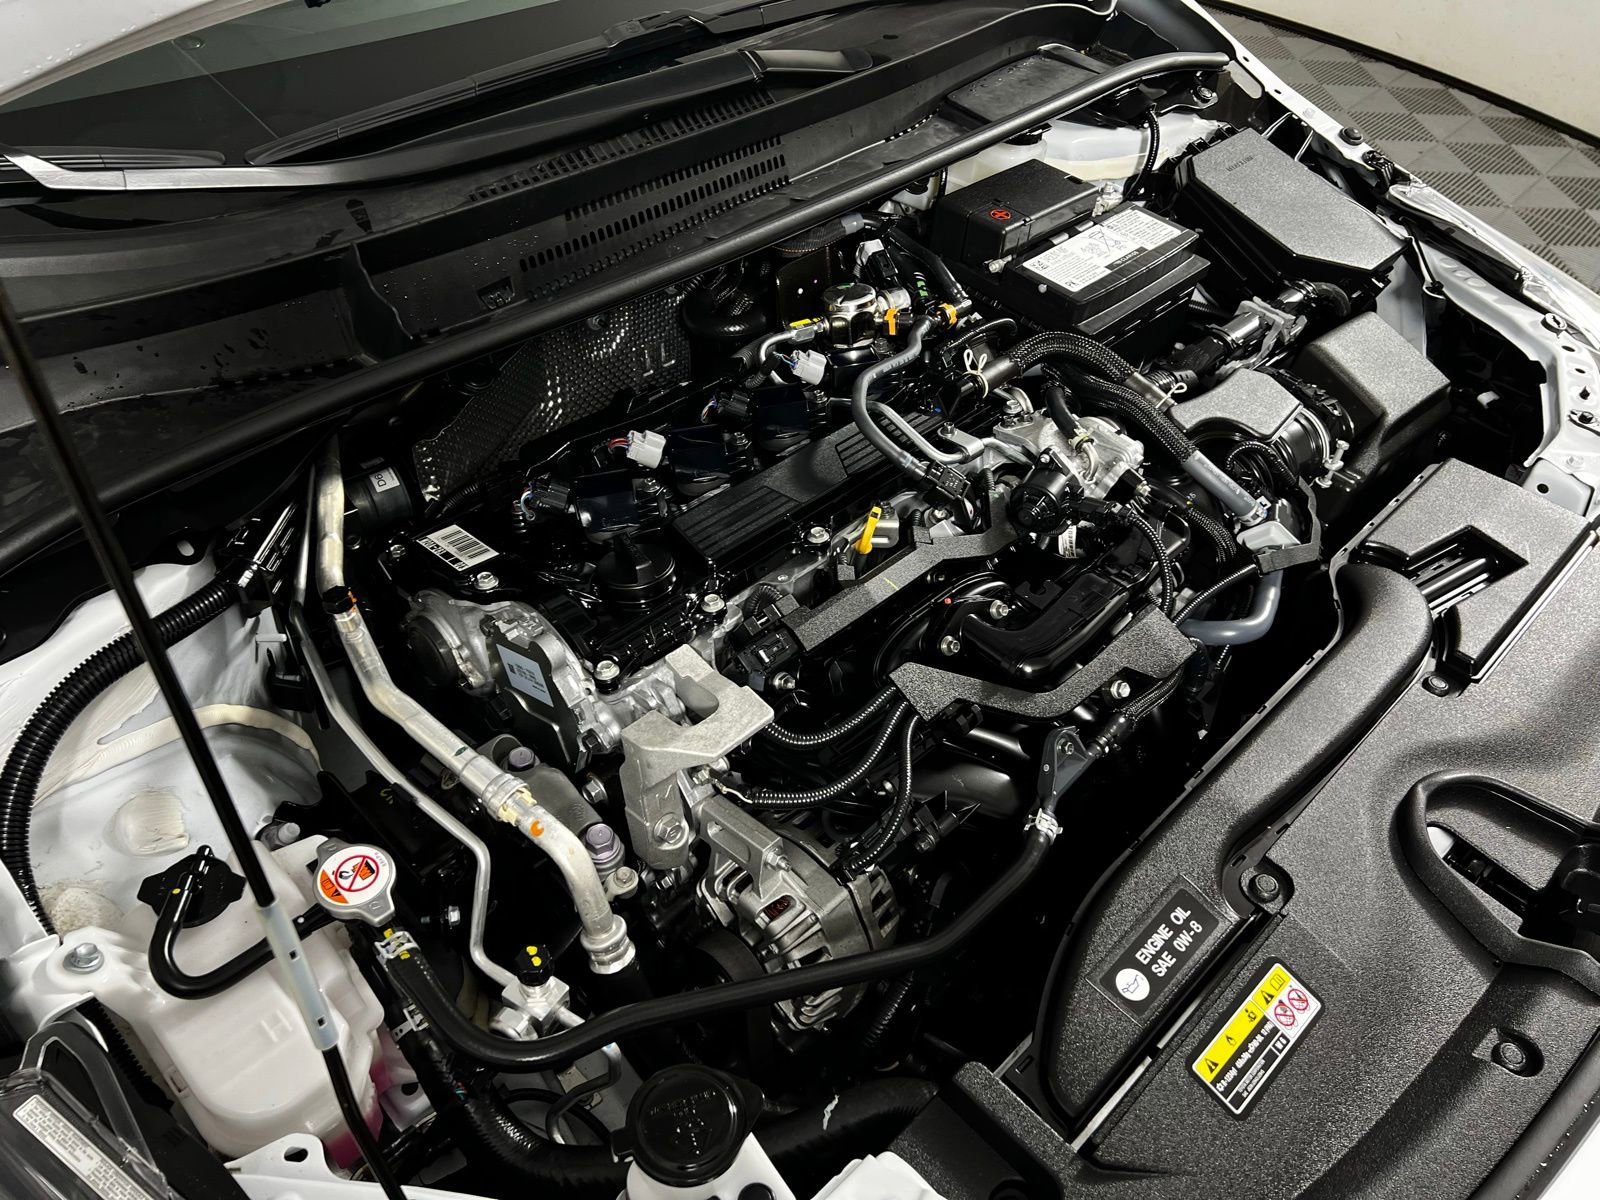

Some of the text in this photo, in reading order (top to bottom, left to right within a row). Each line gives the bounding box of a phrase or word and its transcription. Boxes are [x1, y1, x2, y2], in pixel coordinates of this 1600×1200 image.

[1135, 906, 1191, 965] ENGINE OIL
[1151, 920, 1203, 978] SAE 0W-8
